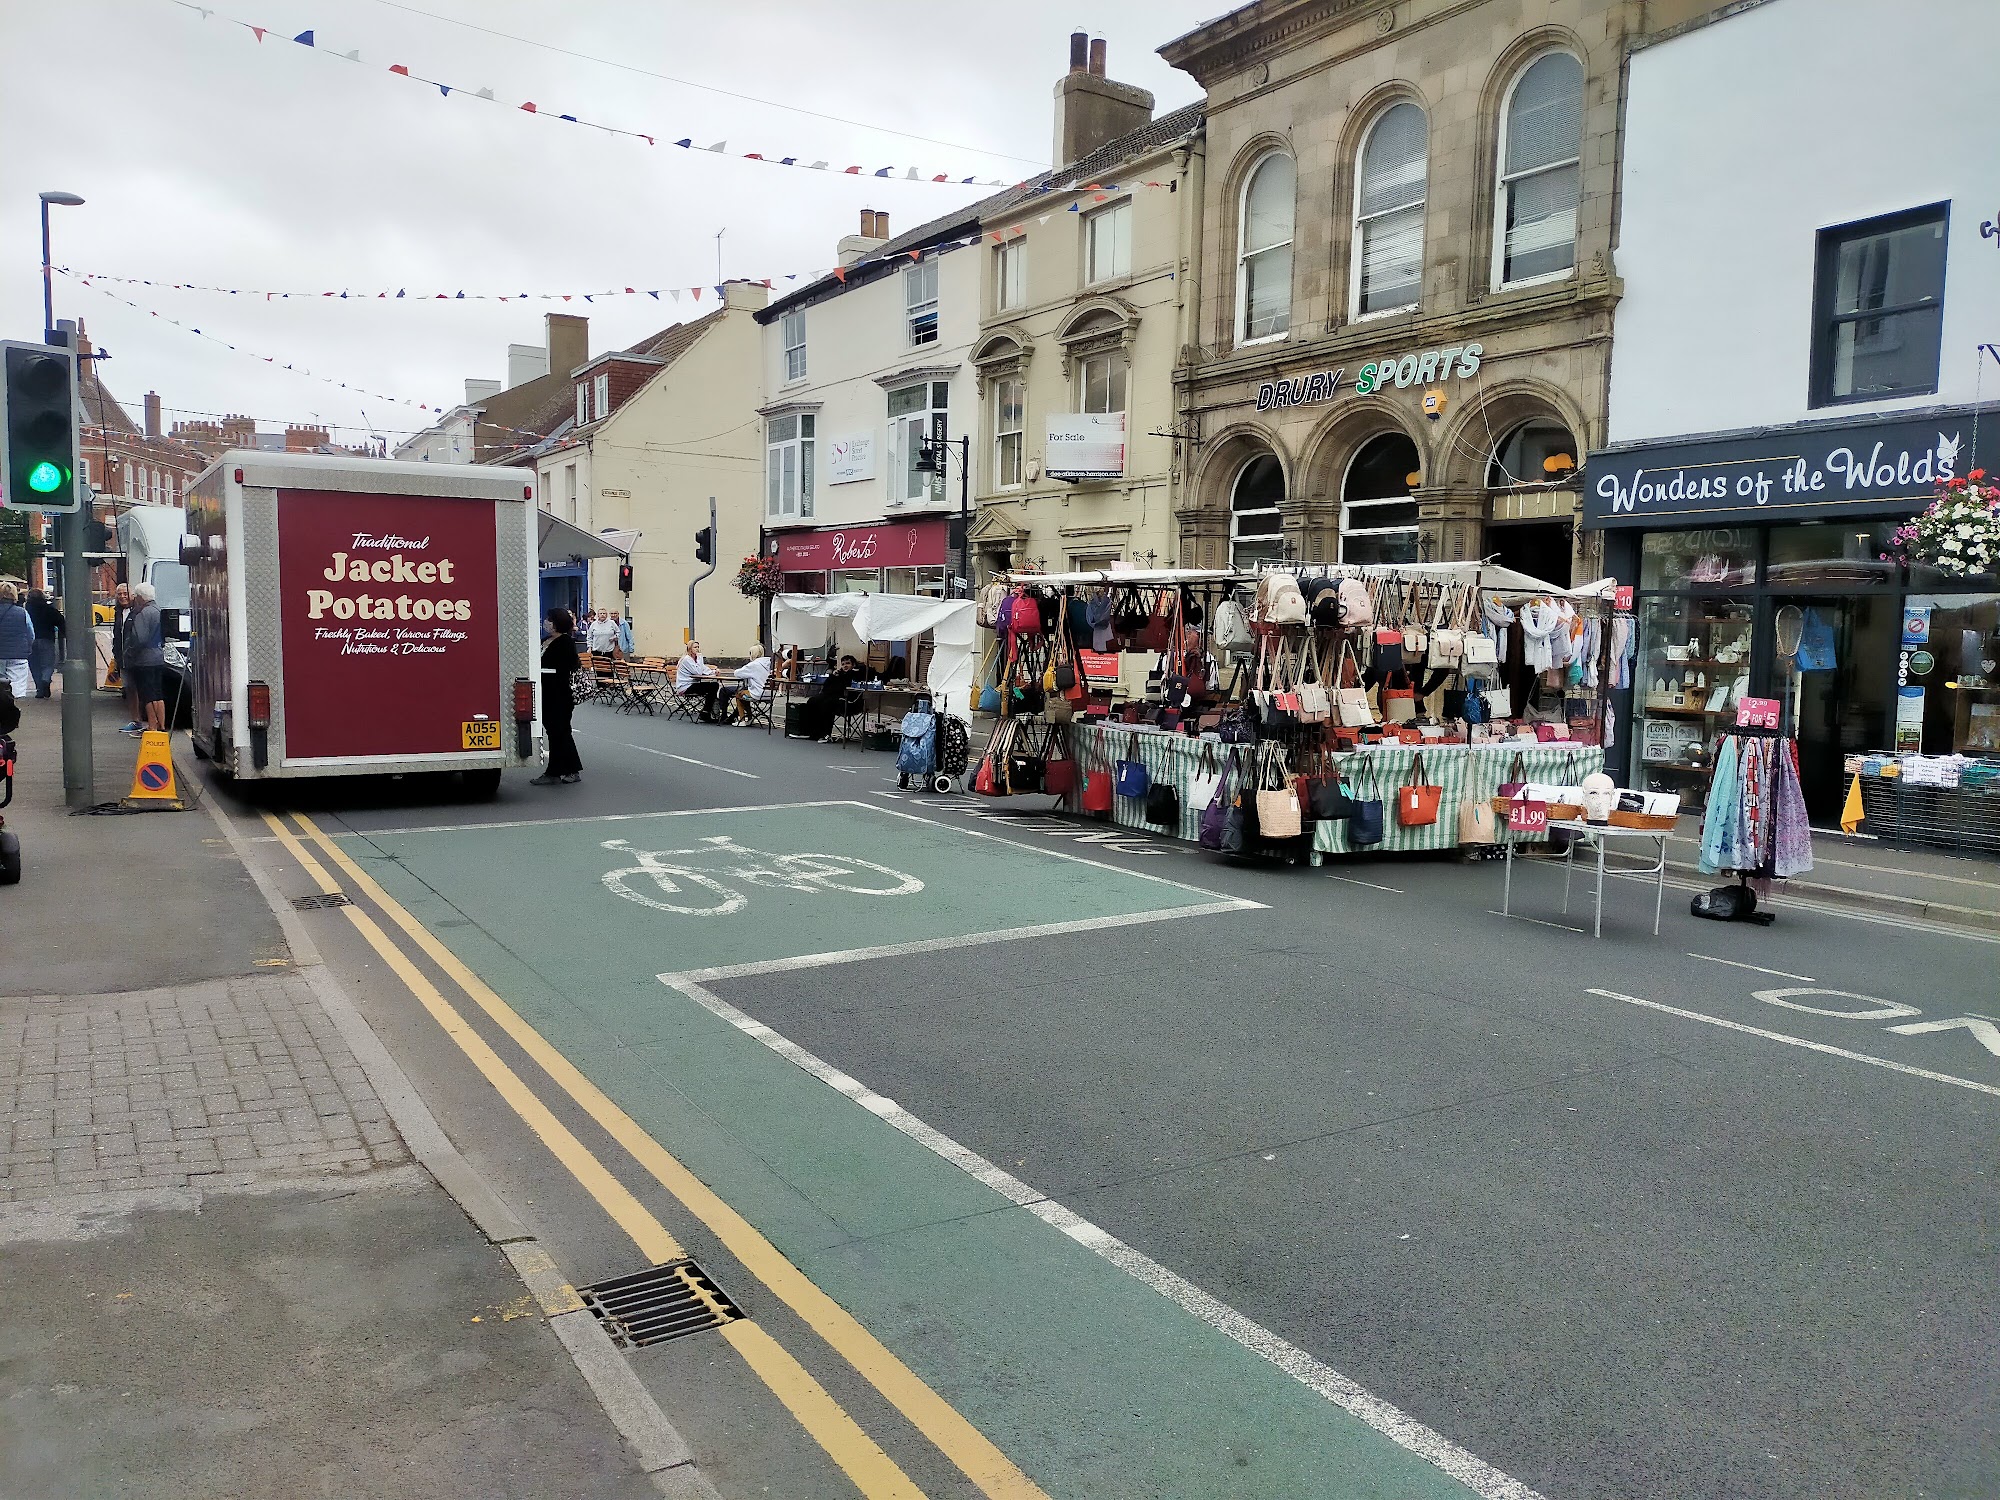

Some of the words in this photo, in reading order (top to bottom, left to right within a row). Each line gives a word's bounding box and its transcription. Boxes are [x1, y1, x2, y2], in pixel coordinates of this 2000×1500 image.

[1256, 368, 1345, 412] DRURY
[1356, 343, 1483, 396] SPORTS
[1065, 433, 1085, 441] Sale
[934, 476, 943, 494] NHS
[1597, 469, 1727, 512] Wonders
[1736, 472, 1773, 505] of
[1782, 458, 1825, 493] the
[1826, 441, 1955, 489] Wolds
[803, 495, 811, 512] NHS
[351, 531, 430, 551] Traditional
[324, 552, 455, 584] Jacket
[306, 589, 472, 621] Potatoes
[315, 627, 352, 643] Freshly
[353, 627, 390, 640] Baked,
[393, 627, 431, 640] Various
[432, 627, 469, 643] Fillings,
[340, 643, 388, 656] Nutritious
[390, 642, 399, 656] &
[401, 642, 446, 655] Delicious
[1748, 700, 1768, 709] £2.99
[1740, 710, 1751, 724] 2
[1752, 713, 1763, 724] FOR
[1763, 711, 1777, 727] £5
[469, 736, 493, 747] XRC
[1510, 805, 1545, 825] £1.99
